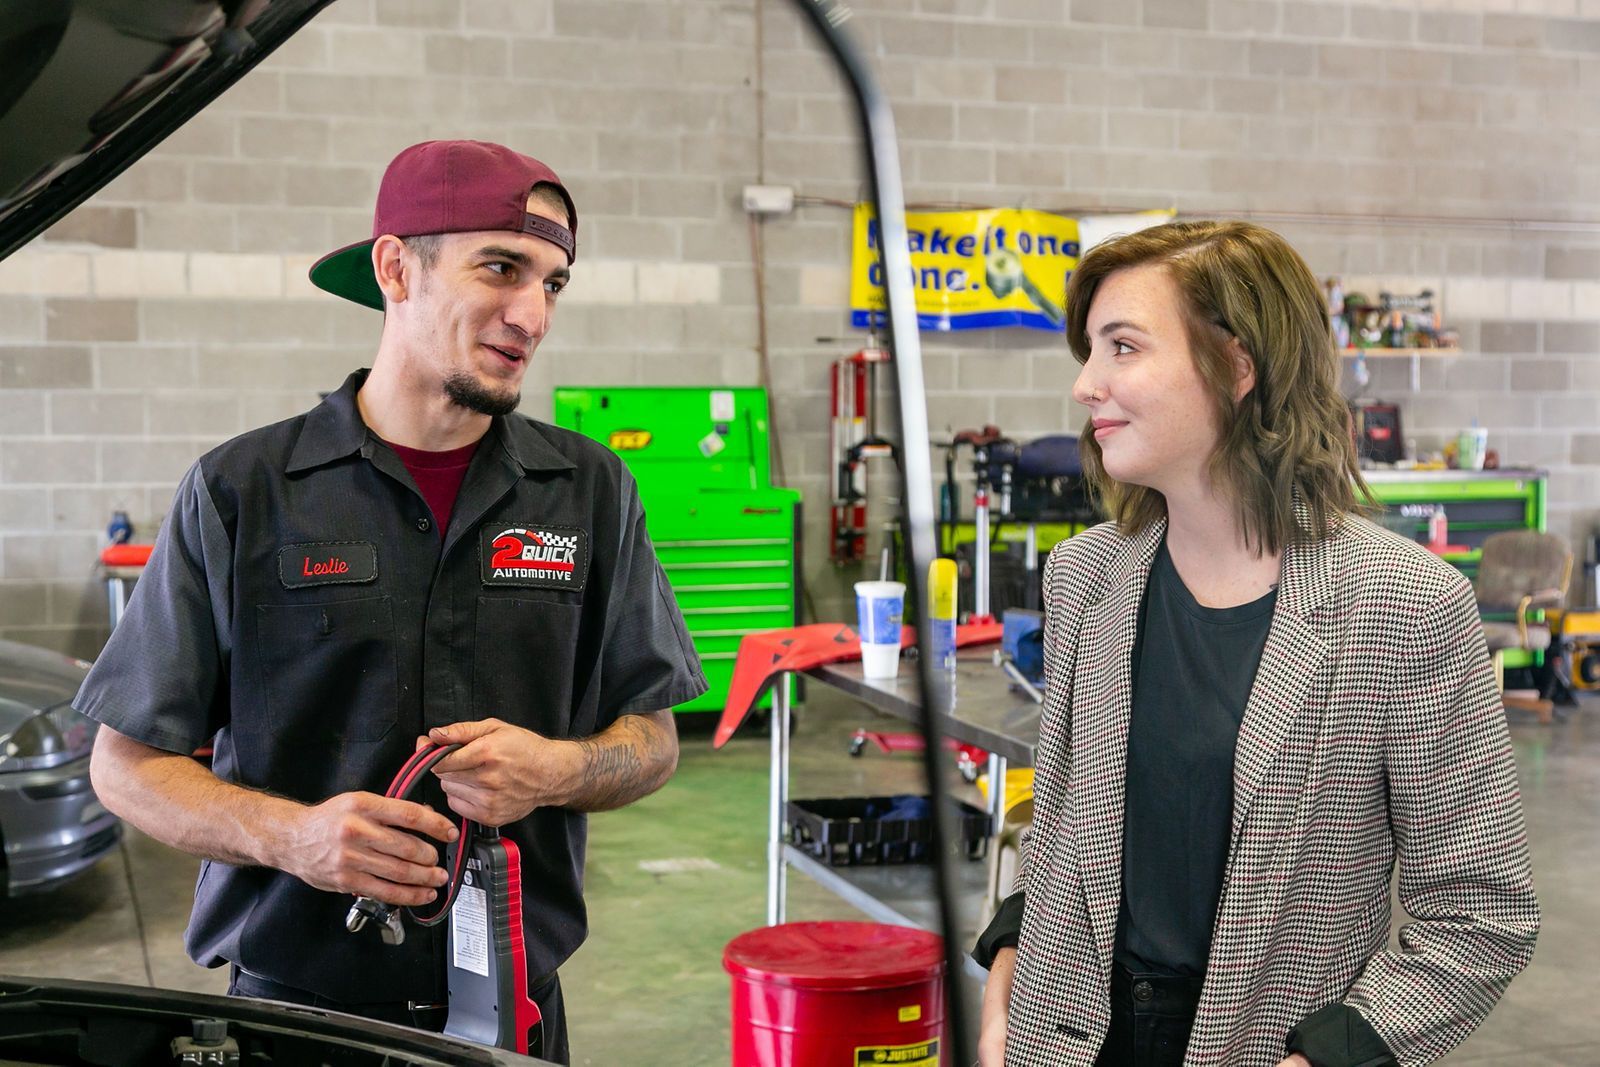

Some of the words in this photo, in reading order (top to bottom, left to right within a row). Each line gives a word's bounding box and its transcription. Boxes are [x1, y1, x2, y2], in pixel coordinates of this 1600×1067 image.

[521, 545, 576, 564] QUICK
[303, 556, 349, 576] Leslie
[493, 568, 571, 580] AUTOMOTIVE
